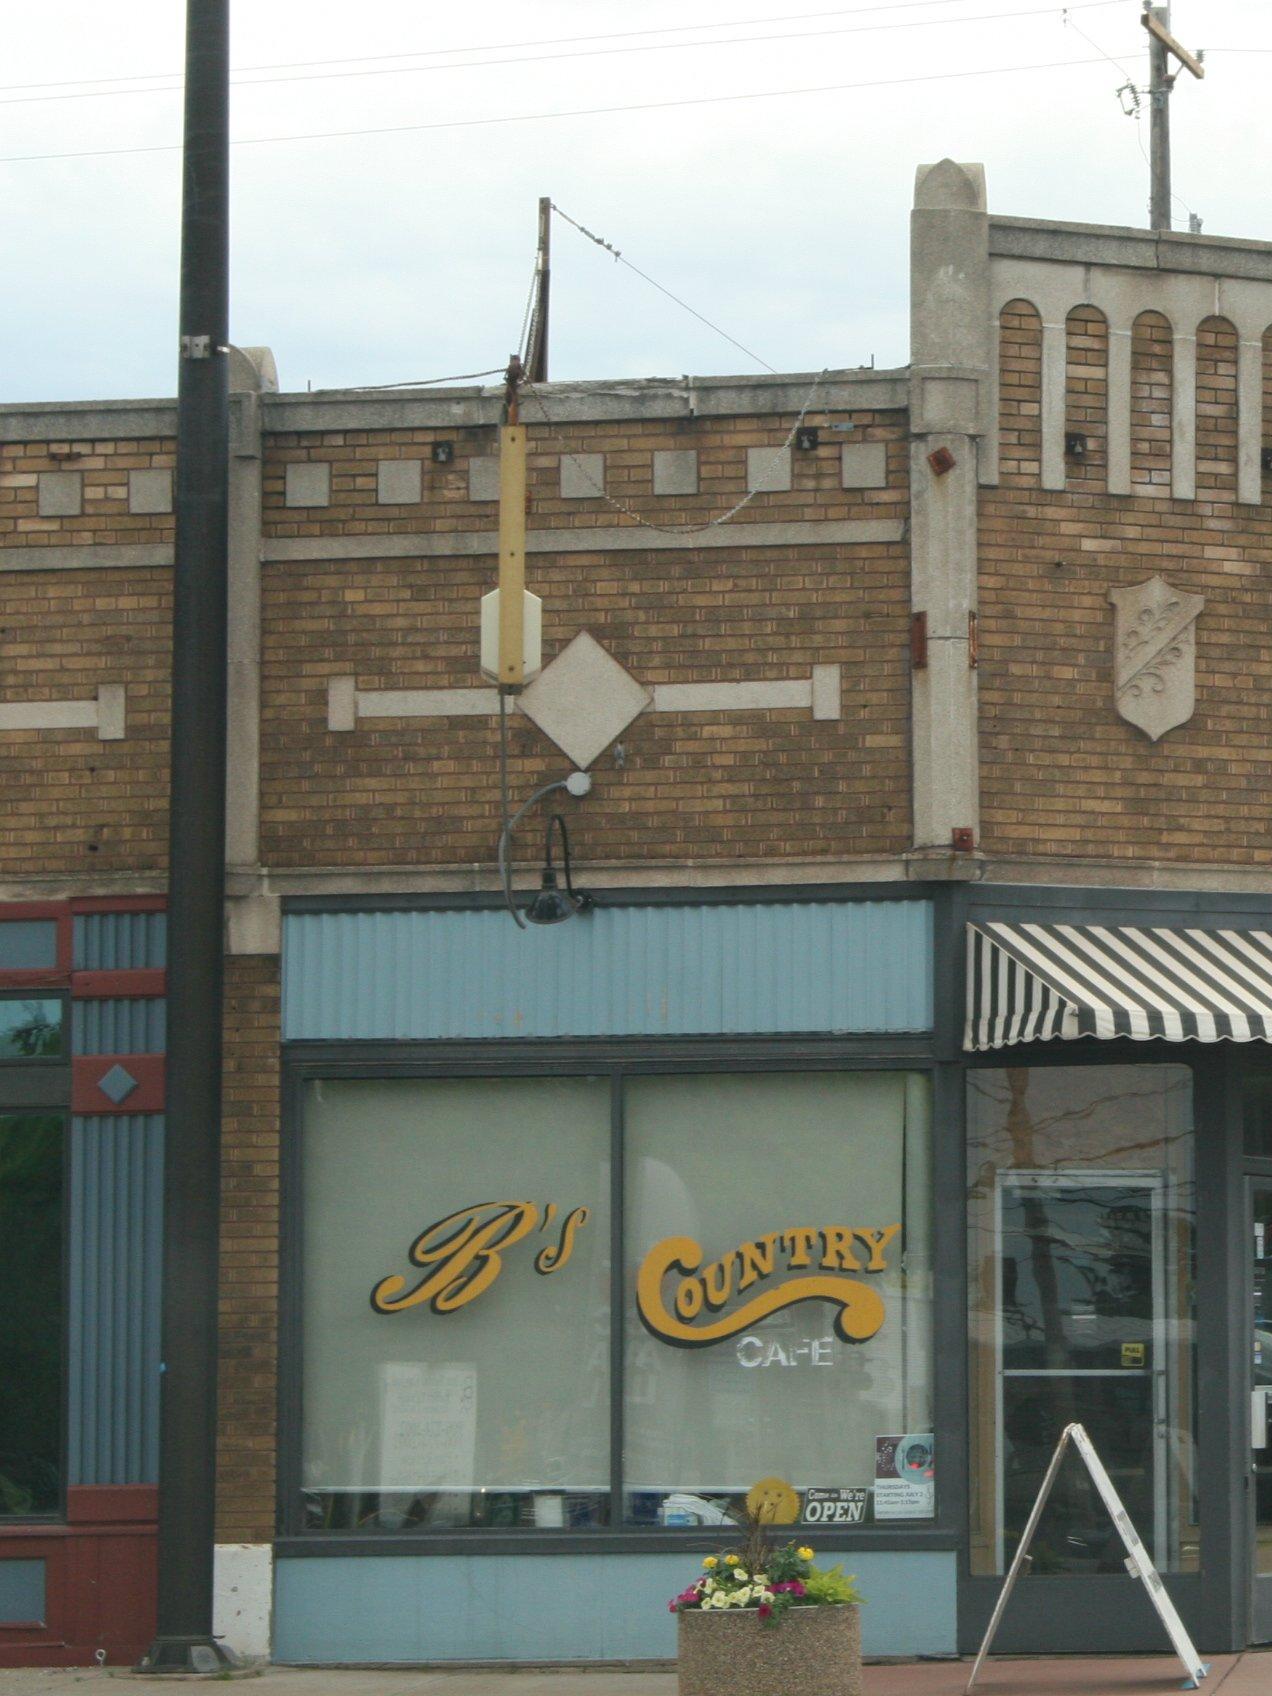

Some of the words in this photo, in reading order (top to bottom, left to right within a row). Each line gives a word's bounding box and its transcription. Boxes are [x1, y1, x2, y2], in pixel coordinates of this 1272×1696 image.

[370, 1201, 590, 1315] B's
[636, 1223, 902, 1349] COUNTRY
[736, 1336, 835, 1369] CAFE
[808, 1489, 829, 1500] Come
[839, 1489, 866, 1500] We're
[805, 1501, 864, 1522] OPEN
